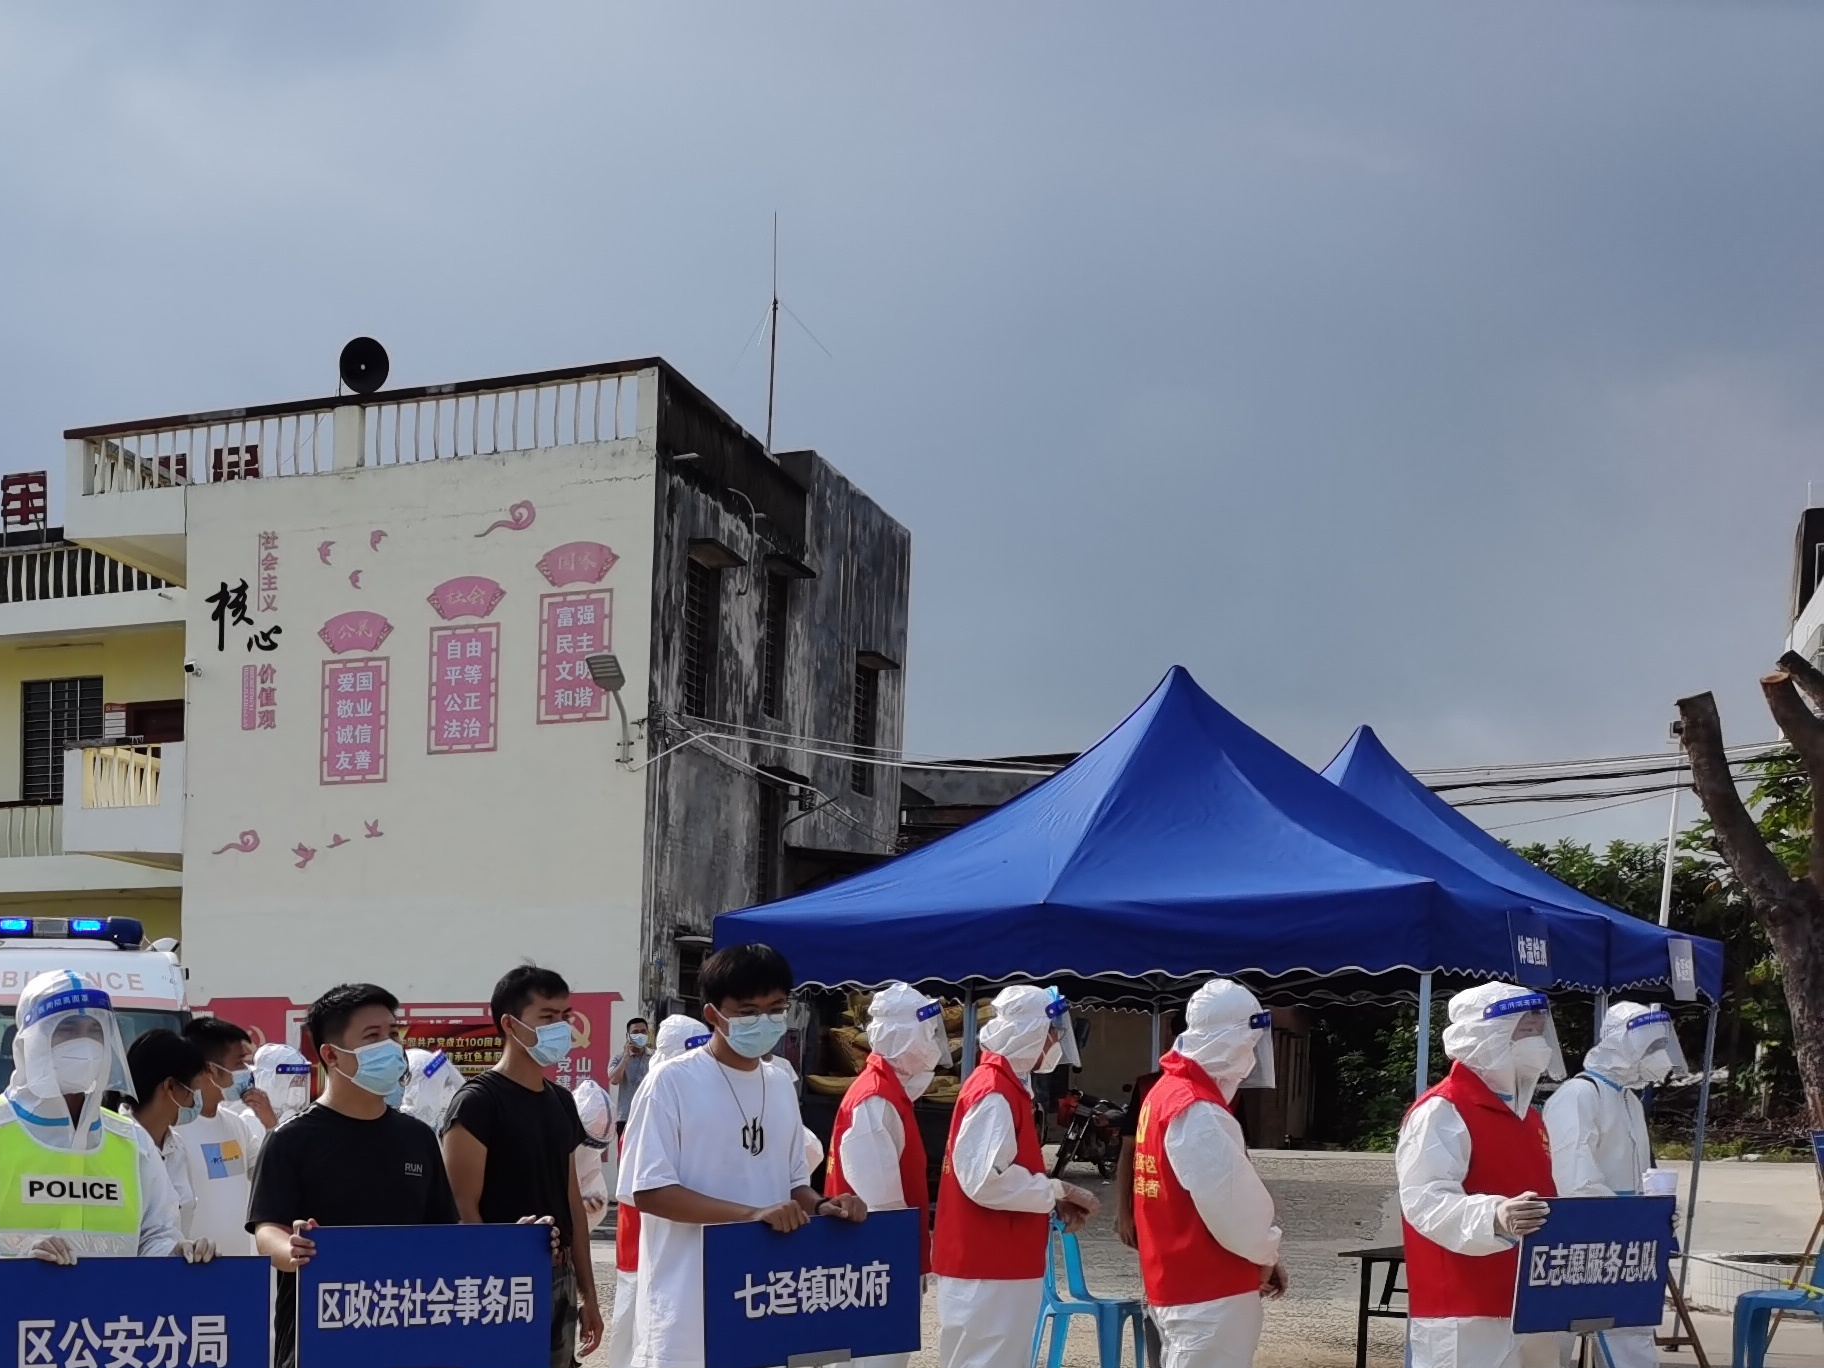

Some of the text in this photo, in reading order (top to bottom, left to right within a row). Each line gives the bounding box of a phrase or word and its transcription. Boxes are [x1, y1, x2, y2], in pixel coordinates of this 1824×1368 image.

[261, 531, 278, 612] 社会主义
[206, 579, 282, 652] 核心
[556, 604, 596, 629] 富强
[446, 637, 483, 660] 自由
[555, 632, 595, 655] 民主
[337, 670, 374, 693] 爱国
[444, 664, 483, 687] 平等
[258, 663, 277, 730] 价值观
[336, 697, 373, 719] 敬业
[444, 690, 482, 713] 公正
[554, 686, 595, 709] 和谐
[336, 723, 372, 745] 诚信
[443, 717, 482, 740] 法治
[335, 750, 372, 771] 友善
[404, 1162, 423, 1173] RUN
[28, 1180, 119, 1201] POLICE
[1529, 1239, 1658, 1287] 区志愿服务总队
[734, 1259, 891, 1321] 七迳镇政府
[317, 1275, 534, 1330] 区政法社会事务局
